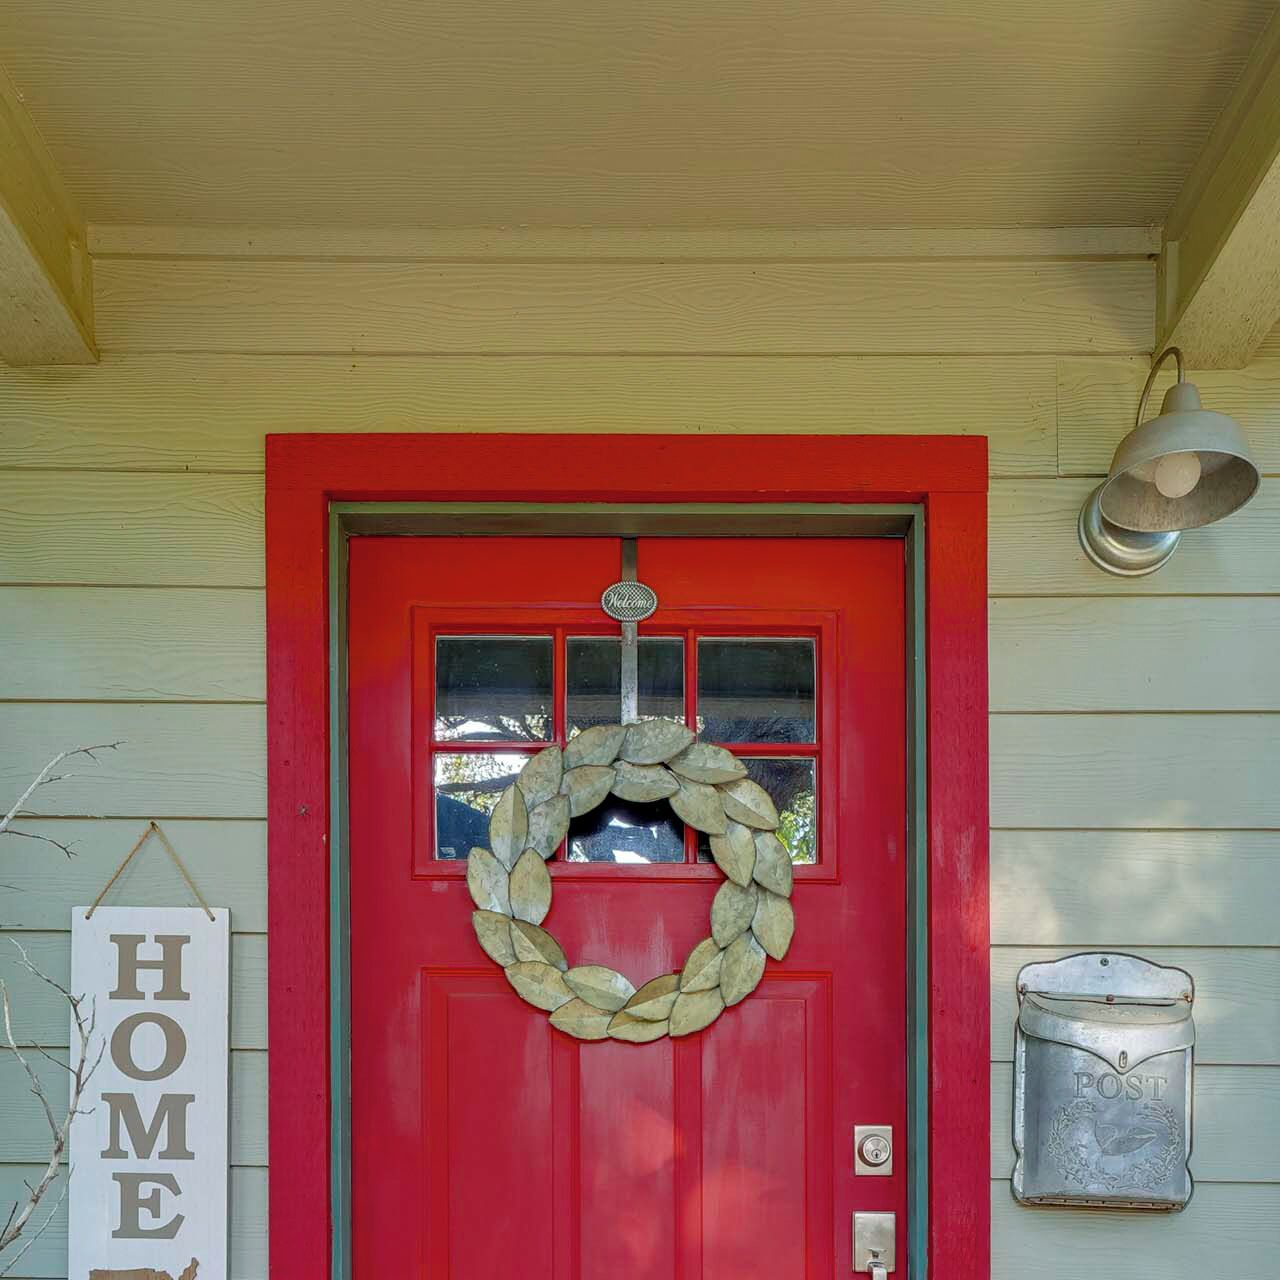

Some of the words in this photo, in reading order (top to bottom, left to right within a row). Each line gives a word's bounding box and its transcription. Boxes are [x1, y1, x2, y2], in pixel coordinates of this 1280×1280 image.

[606, 591, 653, 608] Welcome
[100, 933, 195, 1240] HOME
[1073, 1071, 1168, 1101] POST
